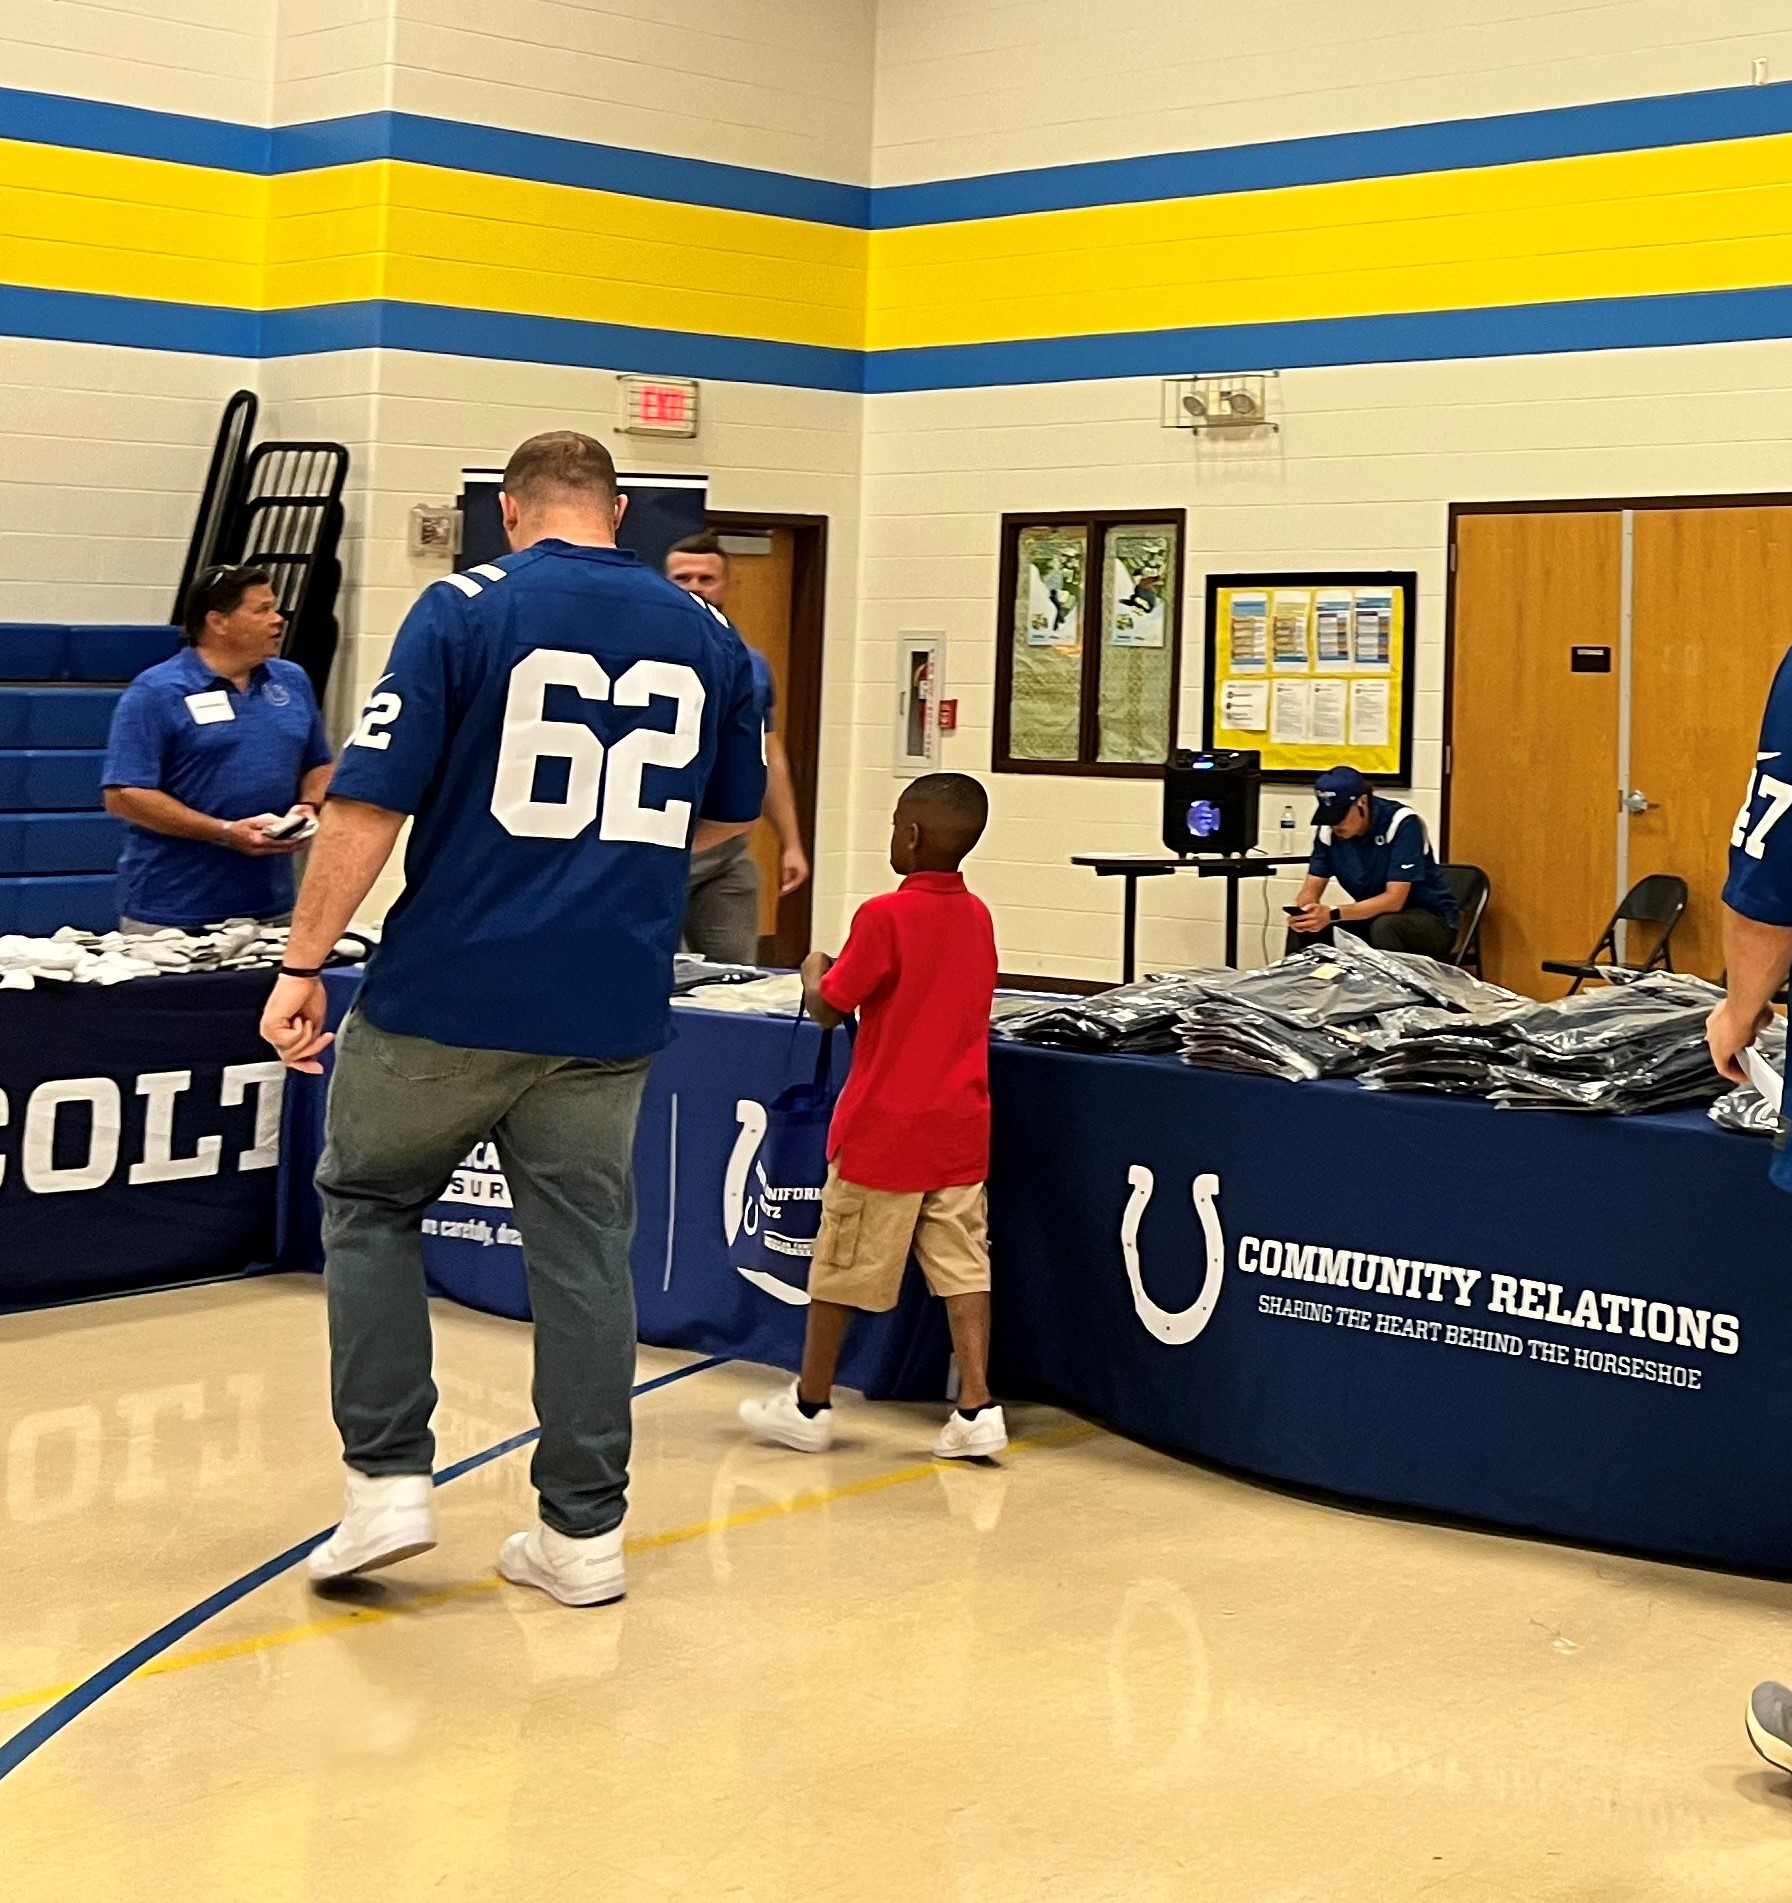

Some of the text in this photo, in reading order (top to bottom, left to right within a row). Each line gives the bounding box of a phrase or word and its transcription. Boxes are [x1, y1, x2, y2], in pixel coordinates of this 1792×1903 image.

[490, 648, 706, 849] 62
[0, 1061, 287, 1194] OLT
[1238, 1236, 1739, 1355] COMMUNITY RELATIONS
[1258, 1294, 1702, 1390] SHARING THE HEART BEHIND THE HORSESHOE
